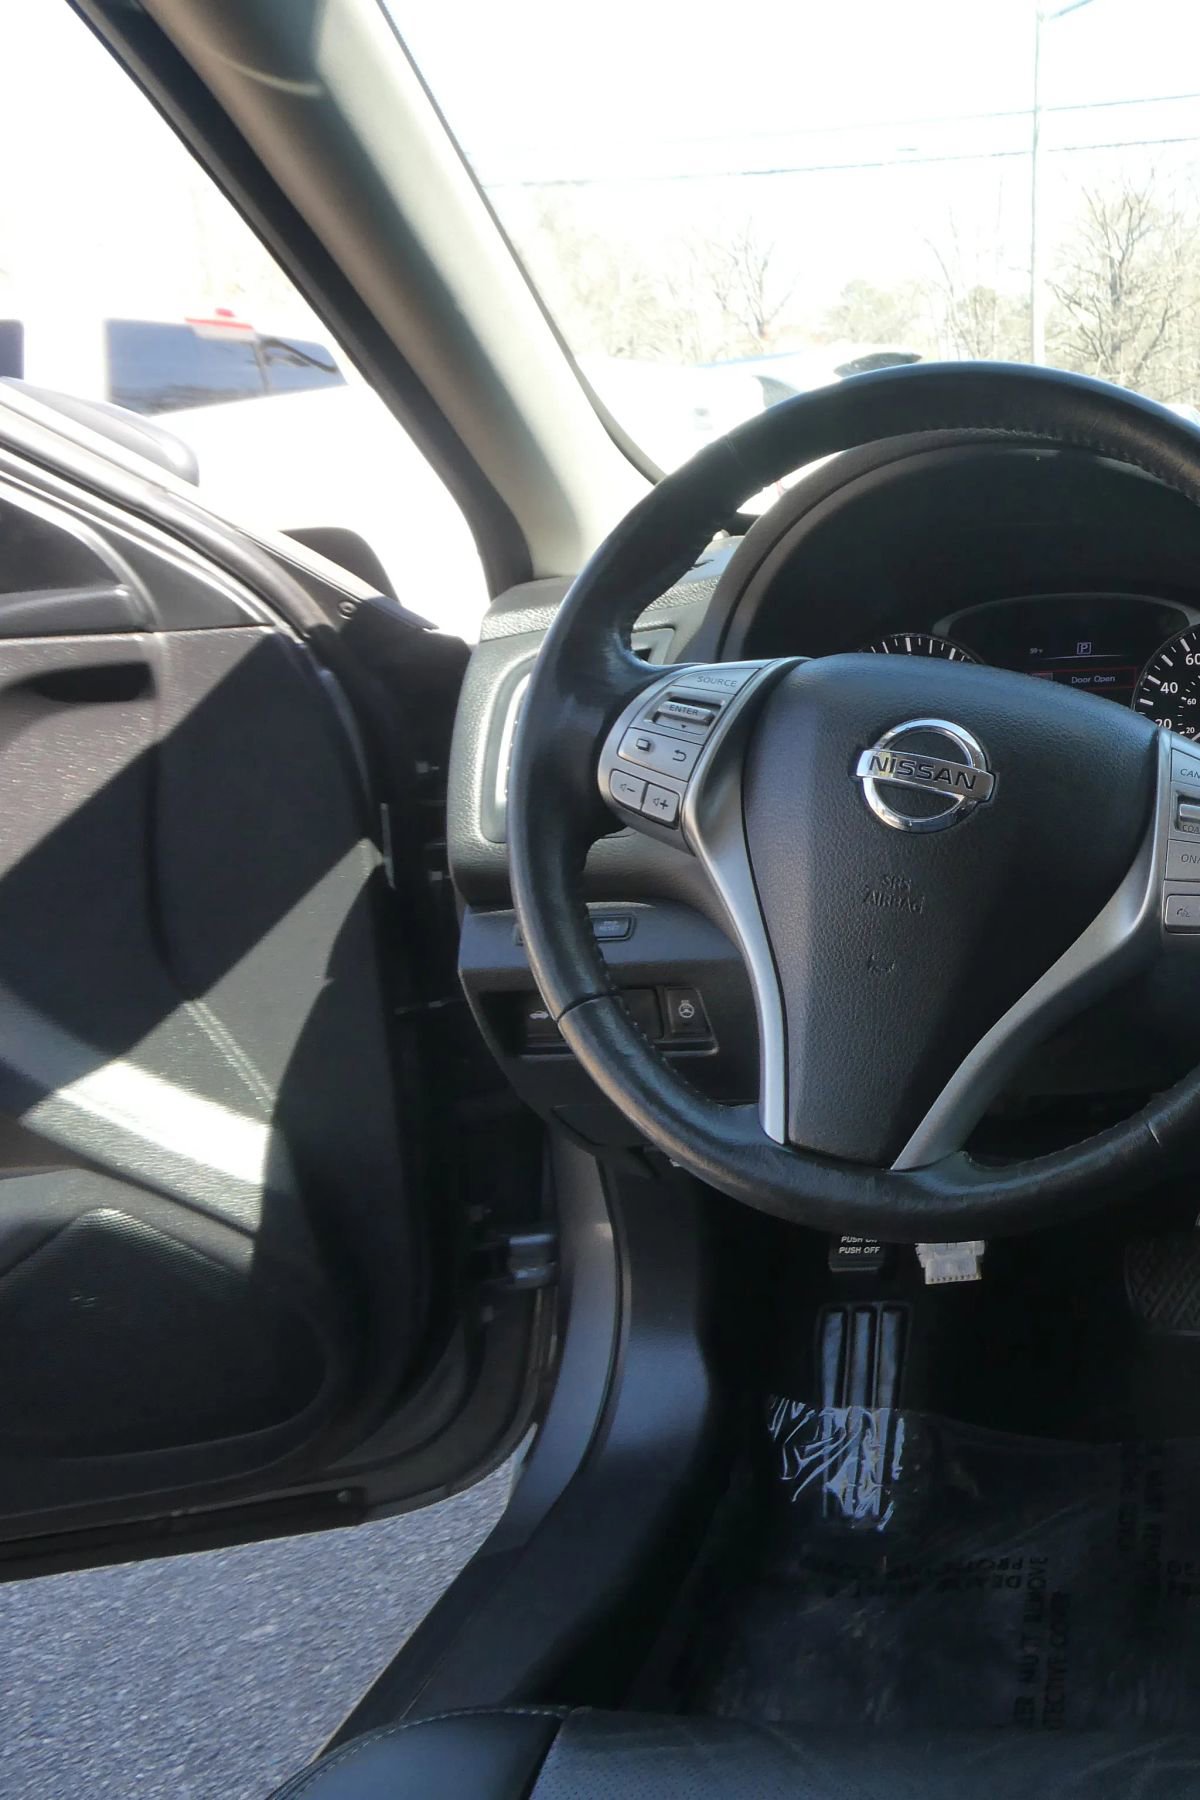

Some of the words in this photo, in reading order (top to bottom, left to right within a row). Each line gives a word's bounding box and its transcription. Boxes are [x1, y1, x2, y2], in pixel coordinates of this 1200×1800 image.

[696, 676, 737, 688] SOURCE
[1094, 676, 1116, 684] Open
[1160, 682, 1178, 694] 40
[669, 704, 698, 716] ENTER
[1156, 718, 1172, 730] 20
[869, 755, 977, 790] NISSAN
